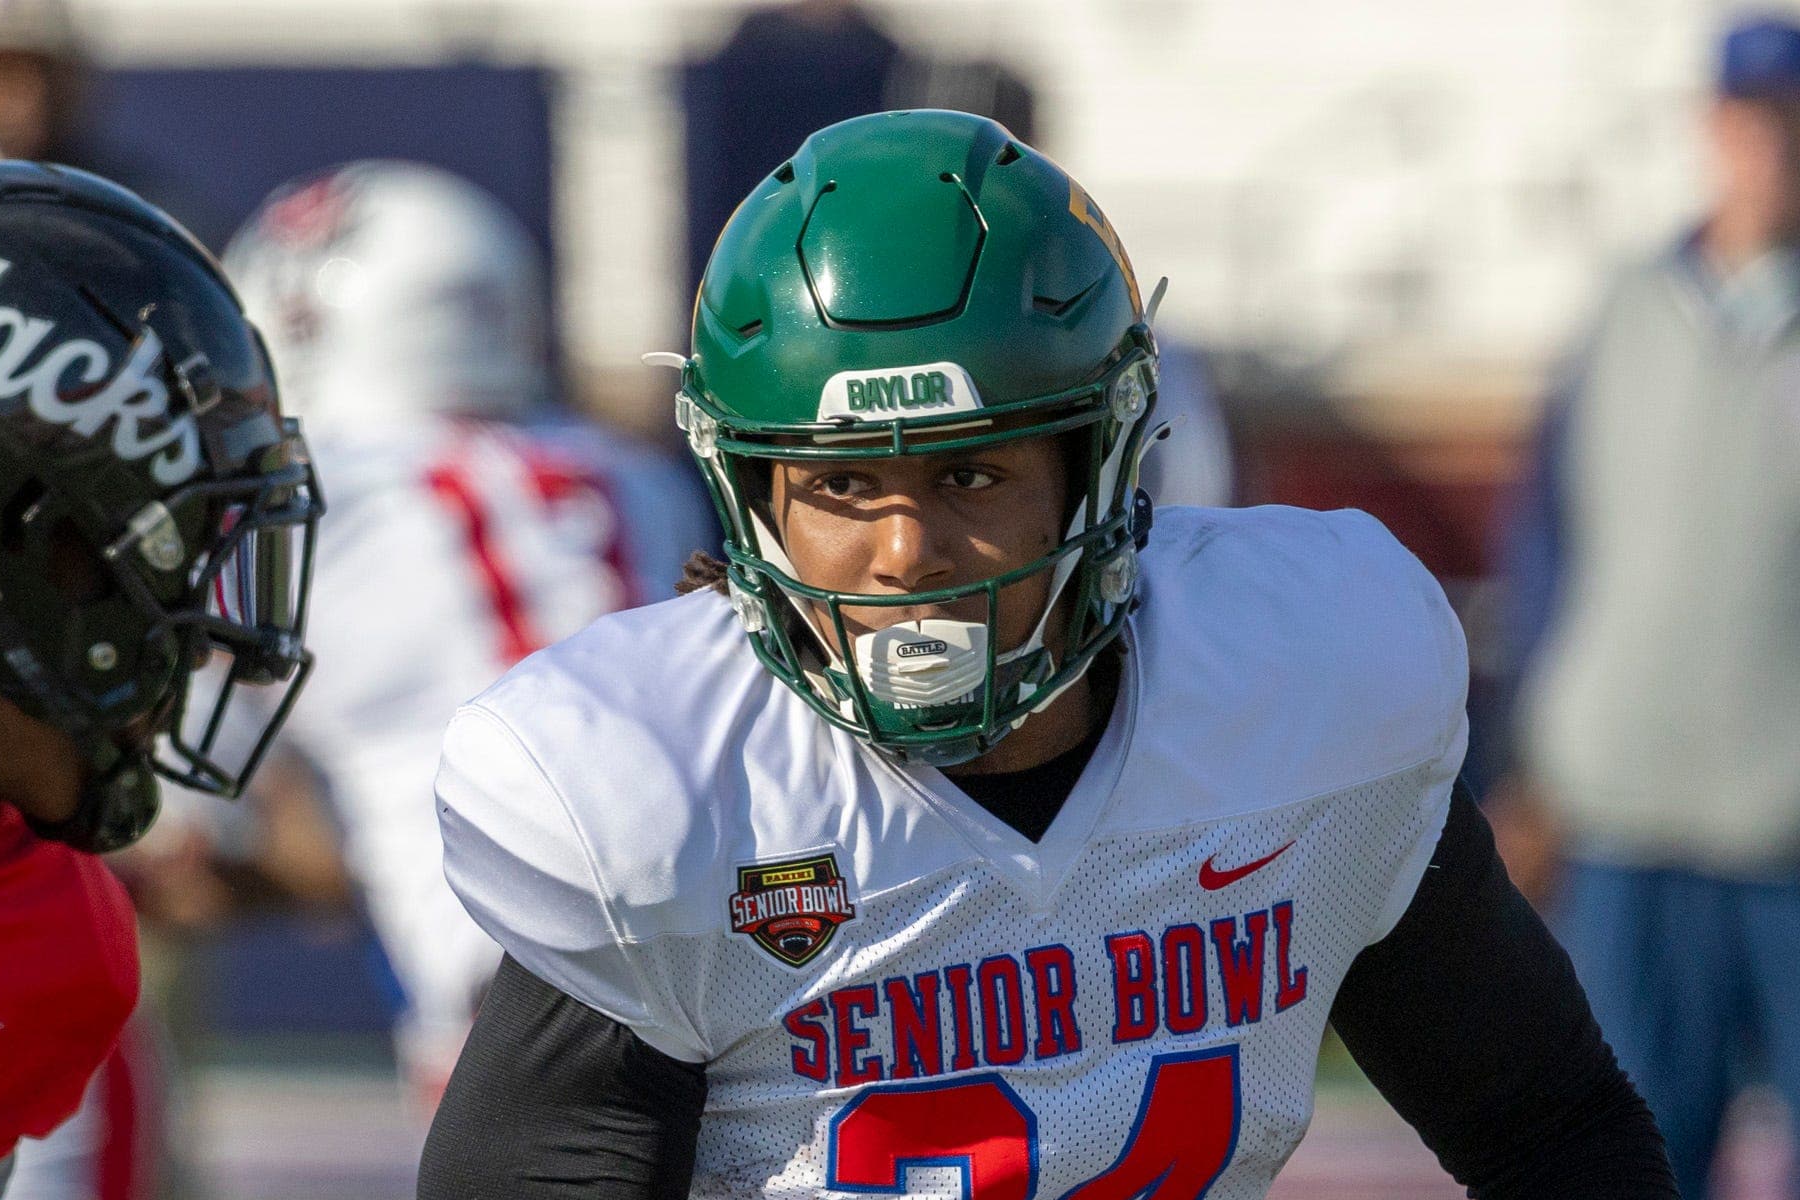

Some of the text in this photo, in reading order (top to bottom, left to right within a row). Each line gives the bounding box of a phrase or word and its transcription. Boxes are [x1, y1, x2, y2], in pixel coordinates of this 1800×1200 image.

[847, 371, 947, 412] BAYLOR
[902, 643, 944, 656] BATTLE
[765, 871, 812, 883] PANINI
[732, 879, 853, 929] SENIOR BOWL
[783, 900, 1307, 1088] SENIOR BOWL
